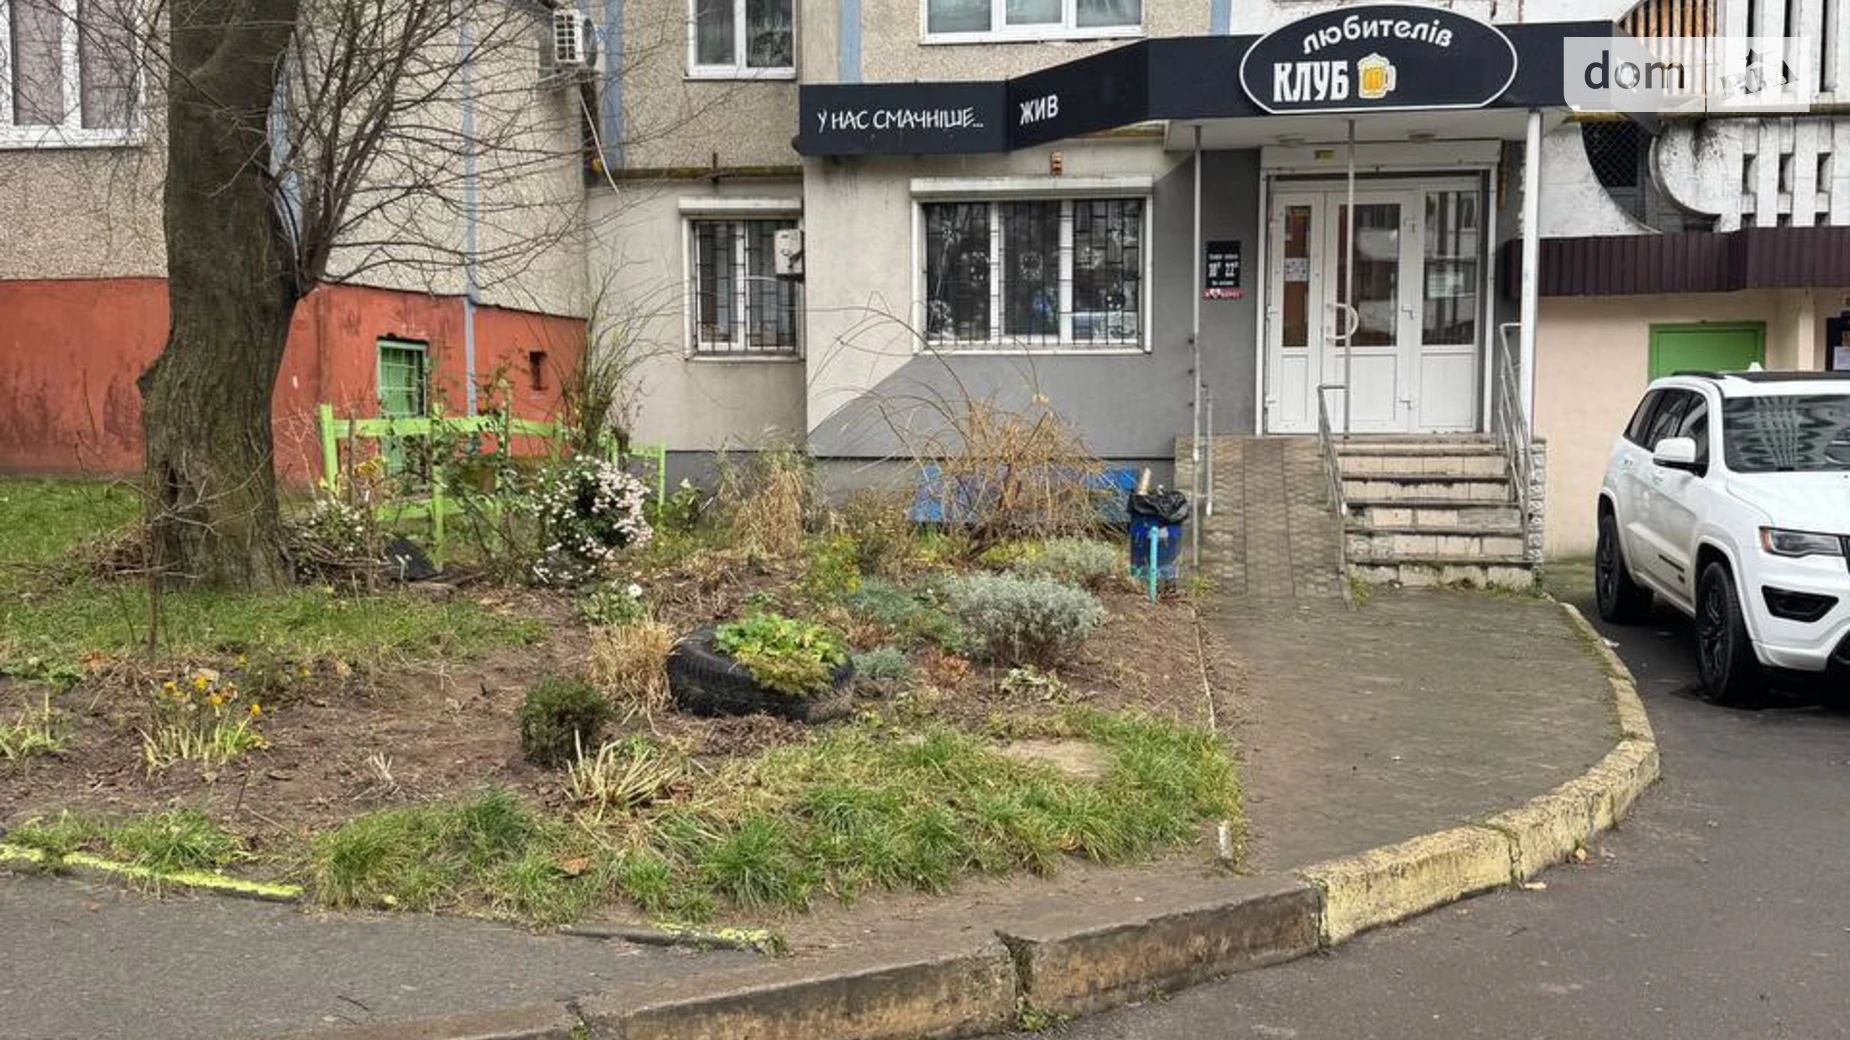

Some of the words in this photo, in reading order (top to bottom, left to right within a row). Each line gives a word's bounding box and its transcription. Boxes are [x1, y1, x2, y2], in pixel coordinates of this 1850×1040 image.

[1303, 15, 1453, 54] любителів
[1273, 60, 1350, 103] КЛУБ
[817, 108, 828, 132] У
[831, 109, 869, 131] НАС
[872, 107, 984, 130] СМАЧНІШЕ...
[1019, 94, 1059, 126] ЖИВ
